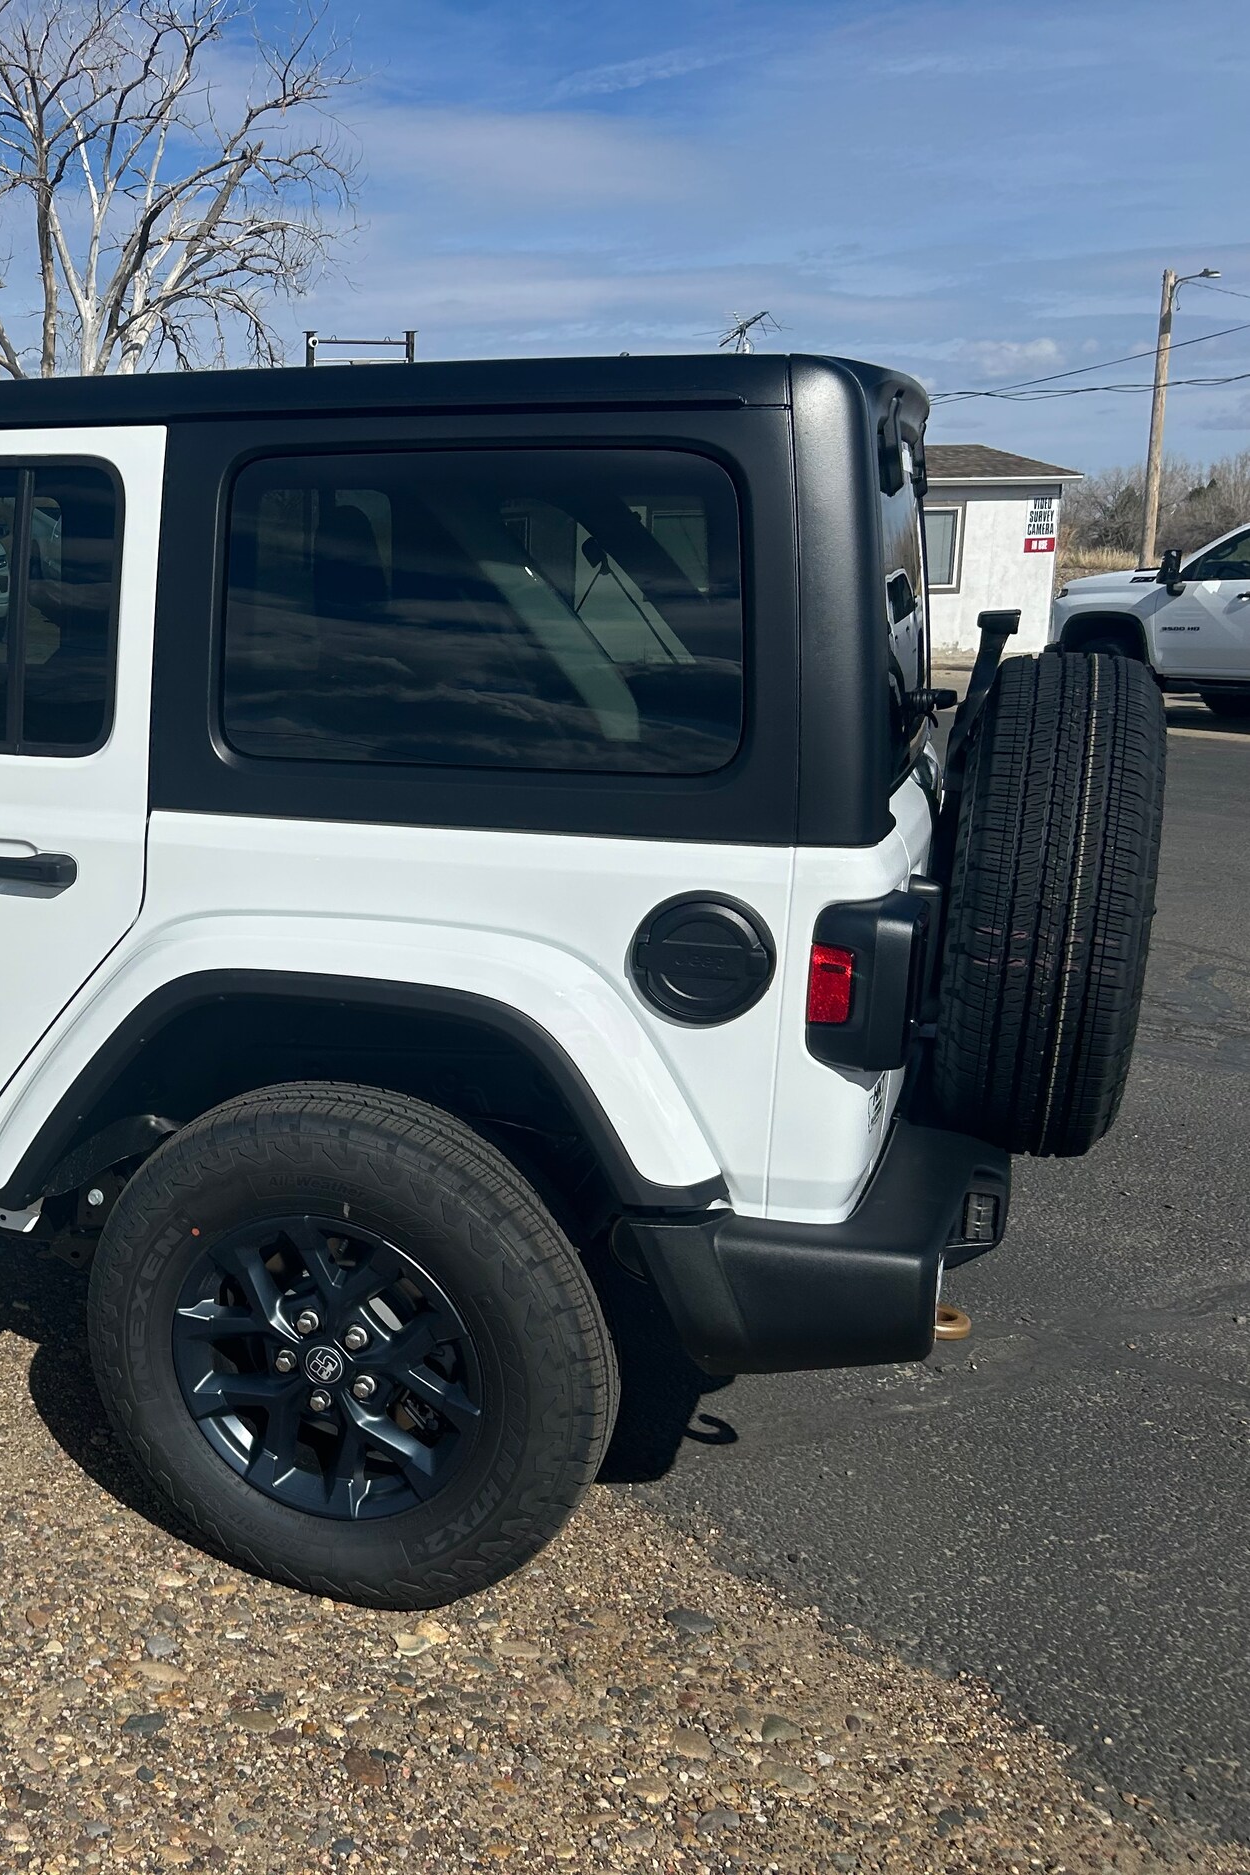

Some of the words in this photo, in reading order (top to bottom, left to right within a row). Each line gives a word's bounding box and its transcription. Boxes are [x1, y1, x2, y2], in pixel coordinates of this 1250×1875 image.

[1033, 497, 1053, 510] VIDEO
[1029, 510, 1054, 522] SURVEY
[129, 1225, 183, 1380] NEXEN
